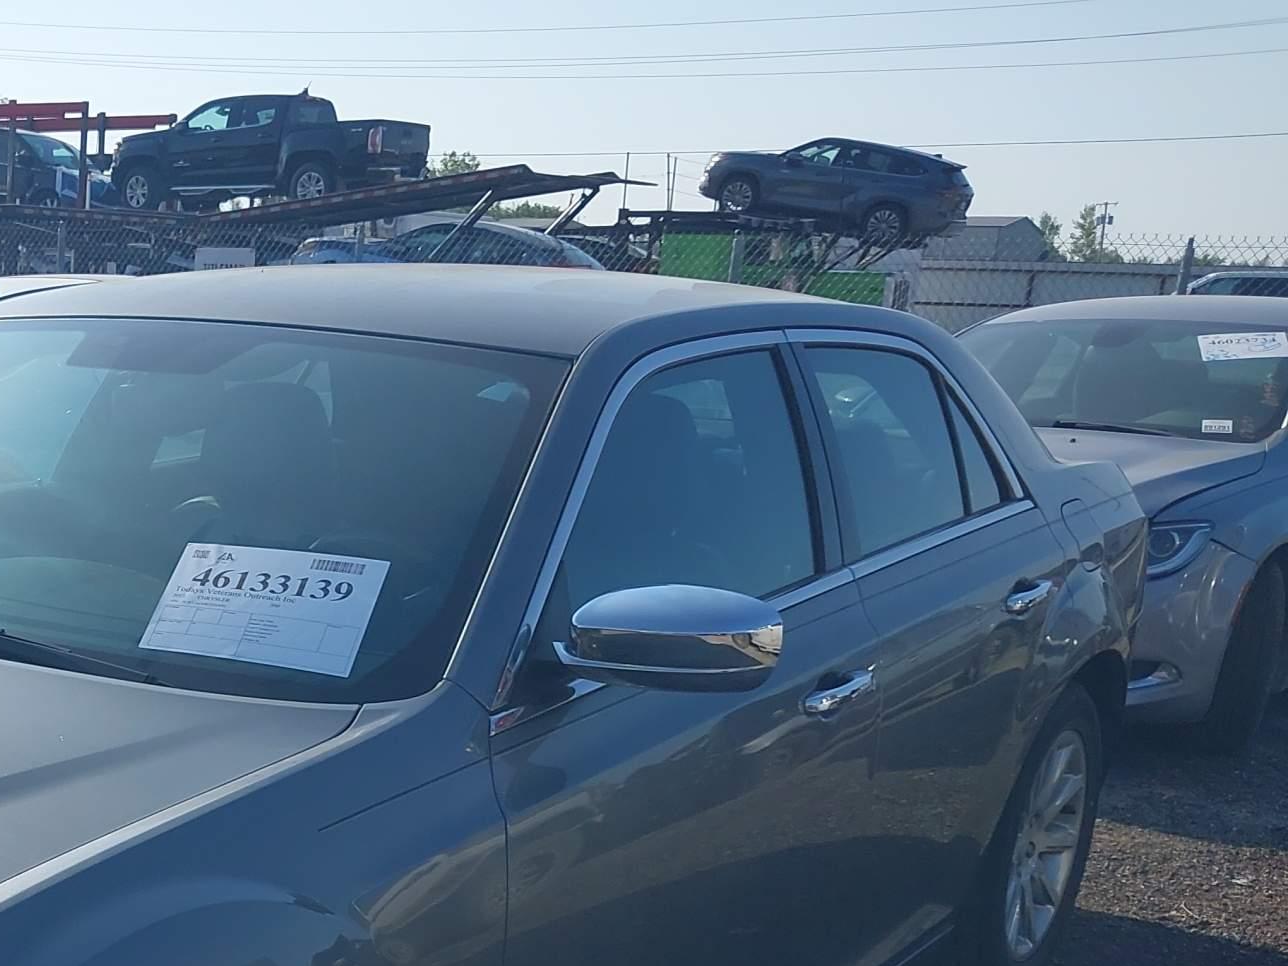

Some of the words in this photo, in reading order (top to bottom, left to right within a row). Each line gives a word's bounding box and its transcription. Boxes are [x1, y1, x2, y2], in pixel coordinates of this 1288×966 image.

[191, 567, 354, 602] 46133139
[207, 586, 242, 598] Veterans
[244, 591, 280, 603] Outreach
[281, 596, 297, 605] Inc
